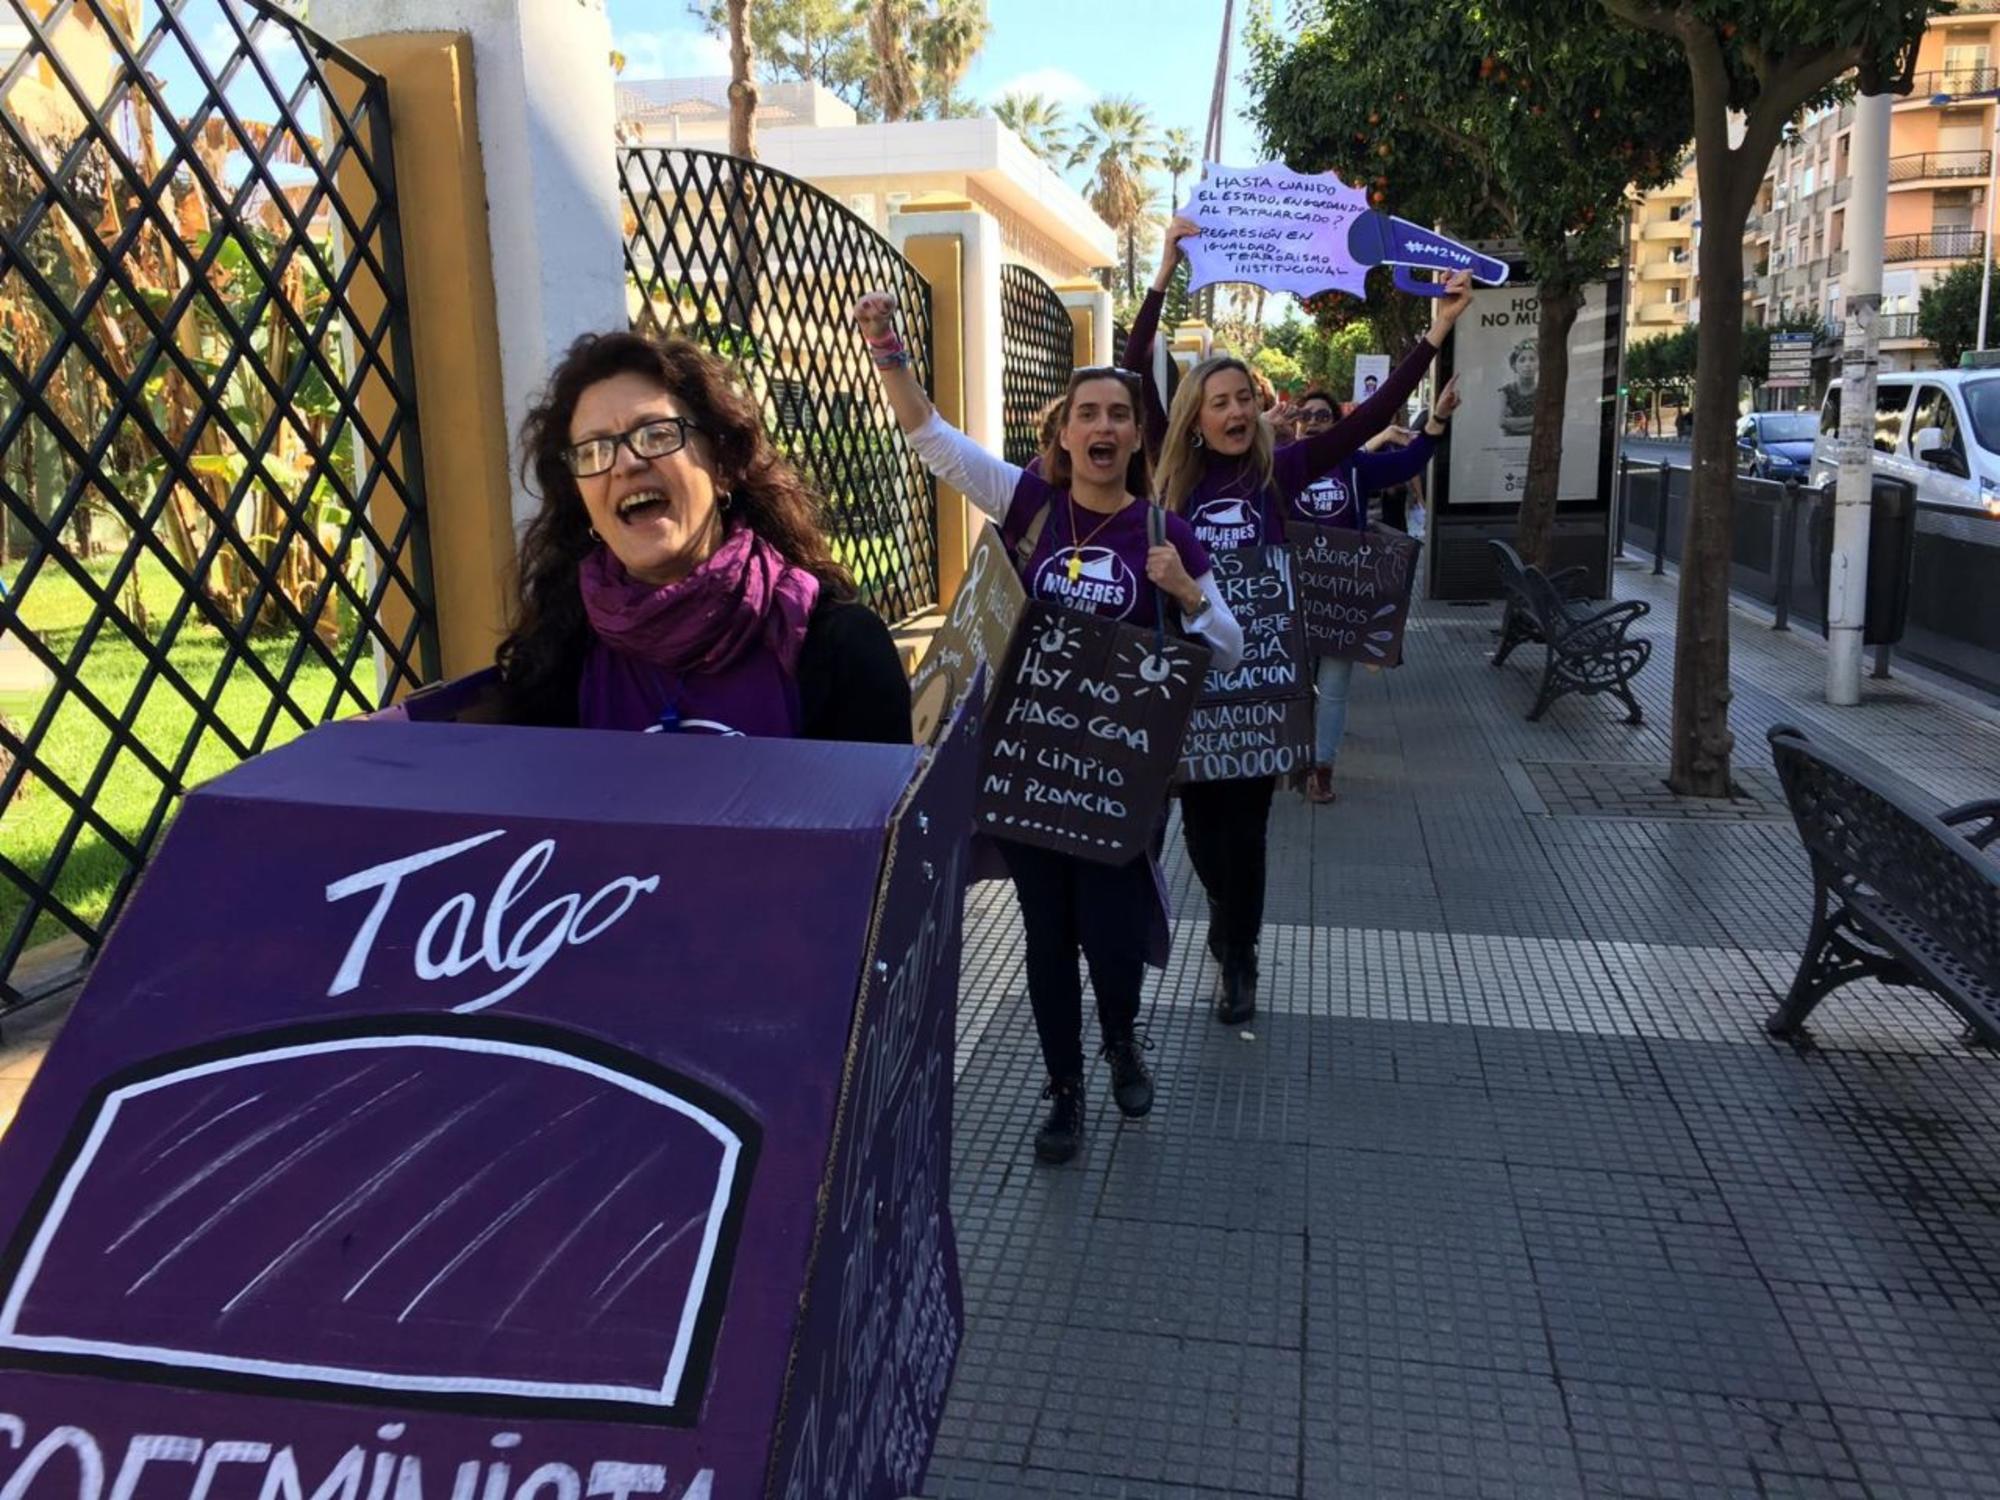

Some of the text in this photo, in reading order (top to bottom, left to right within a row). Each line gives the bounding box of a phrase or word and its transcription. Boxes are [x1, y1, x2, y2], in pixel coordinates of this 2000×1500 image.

[1198, 190, 1218, 202] EL
[1215, 175, 1337, 196] HASTA CUANDO
[1199, 205, 1221, 216] AL
[1286, 230, 1314, 241] EN
[1225, 252, 1330, 264] TERRORISMO
[1511, 298, 1541, 311] HO
[1481, 311, 1541, 327] NO MU
[1194, 523, 1256, 542] MUJERES
[1042, 572, 1126, 606] MUJERES
[1298, 570, 1375, 599] DUCATIVA
[1305, 622, 1357, 651] SUMO
[1204, 659, 1297, 692] STIGACIÓN
[1078, 677, 1121, 704] NO
[1005, 697, 1080, 730] HAGO
[1088, 716, 1150, 753] CENA
[1023, 778, 1128, 818] PLANCHO
[325, 829, 661, 1015] Talgo
